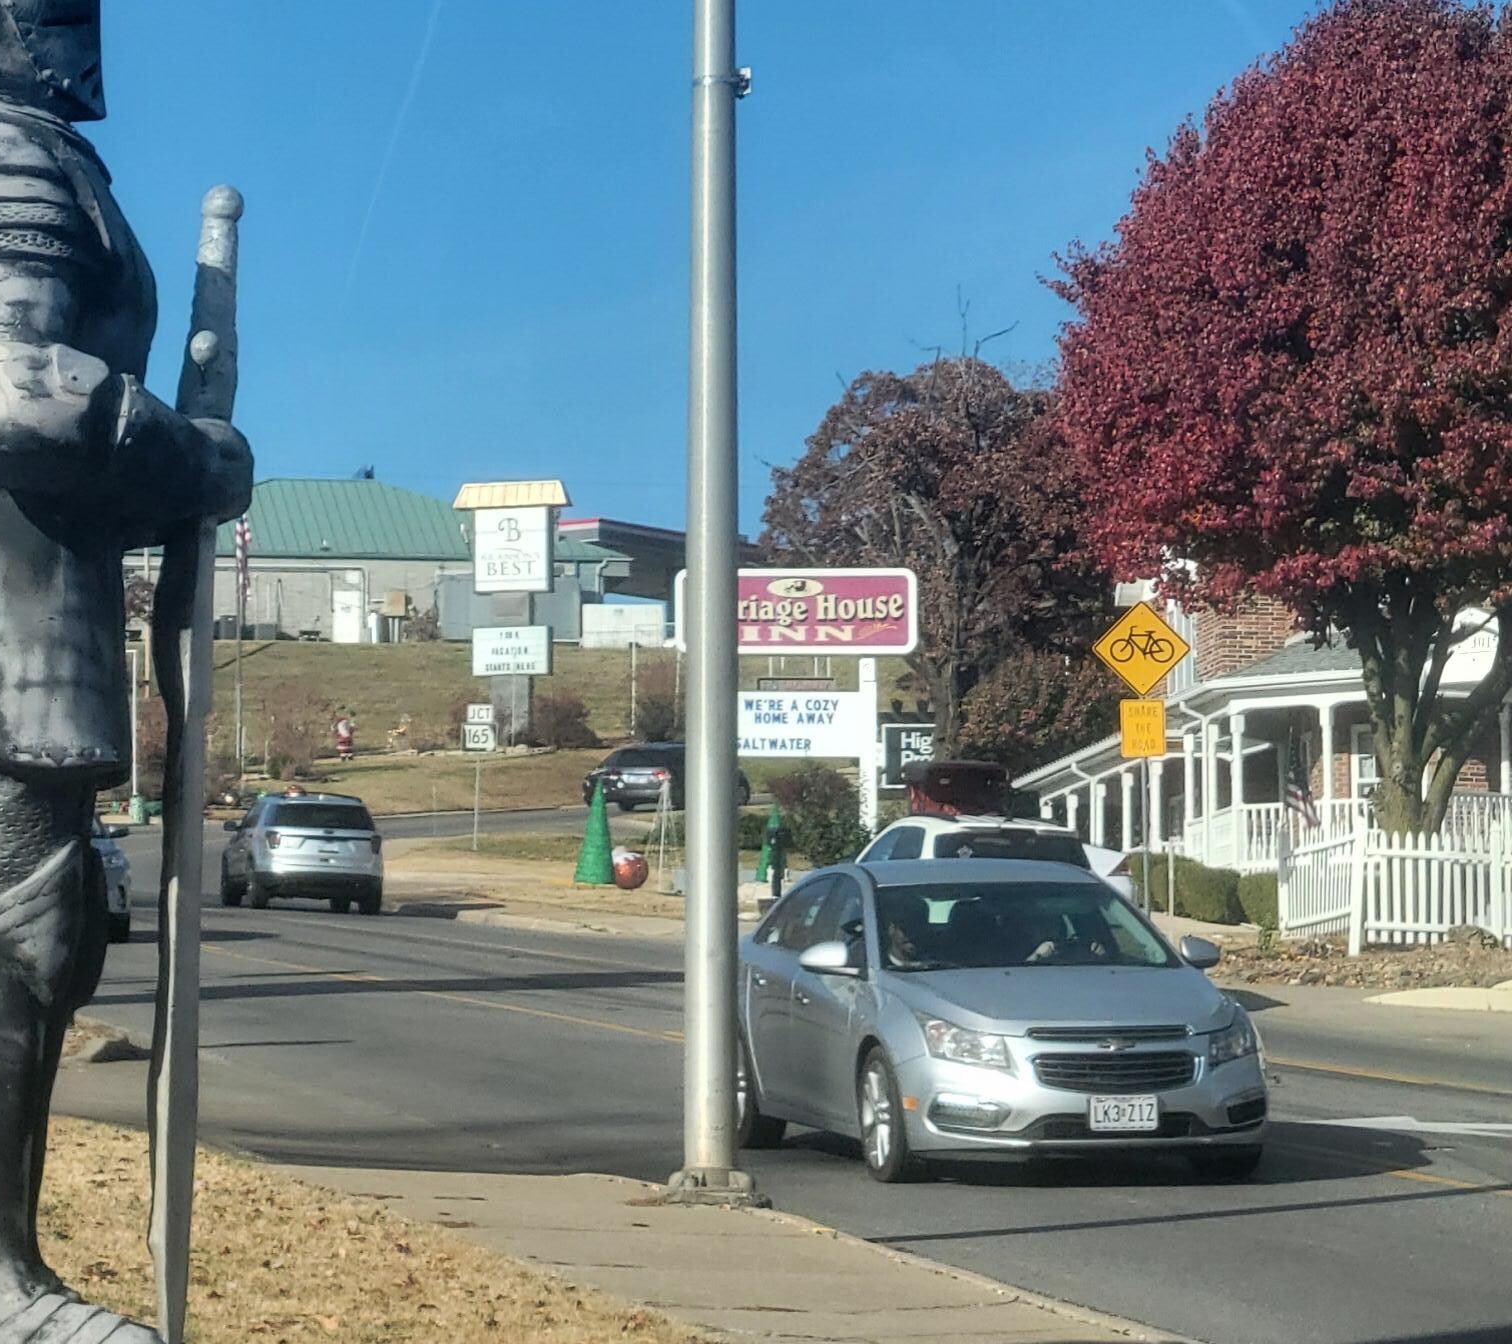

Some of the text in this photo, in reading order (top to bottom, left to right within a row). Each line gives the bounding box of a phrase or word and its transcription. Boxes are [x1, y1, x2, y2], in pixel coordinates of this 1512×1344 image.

[487, 559, 537, 576] BEST
[738, 592, 905, 626] riage House
[741, 624, 856, 642] INN
[469, 707, 491, 720] JCT
[744, 699, 840, 712] WE'RE A COZY
[754, 712, 835, 724] HOME AWAY
[468, 728, 489, 744] 165
[736, 737, 812, 750] SALTWATER
[900, 731, 935, 754] Hig
